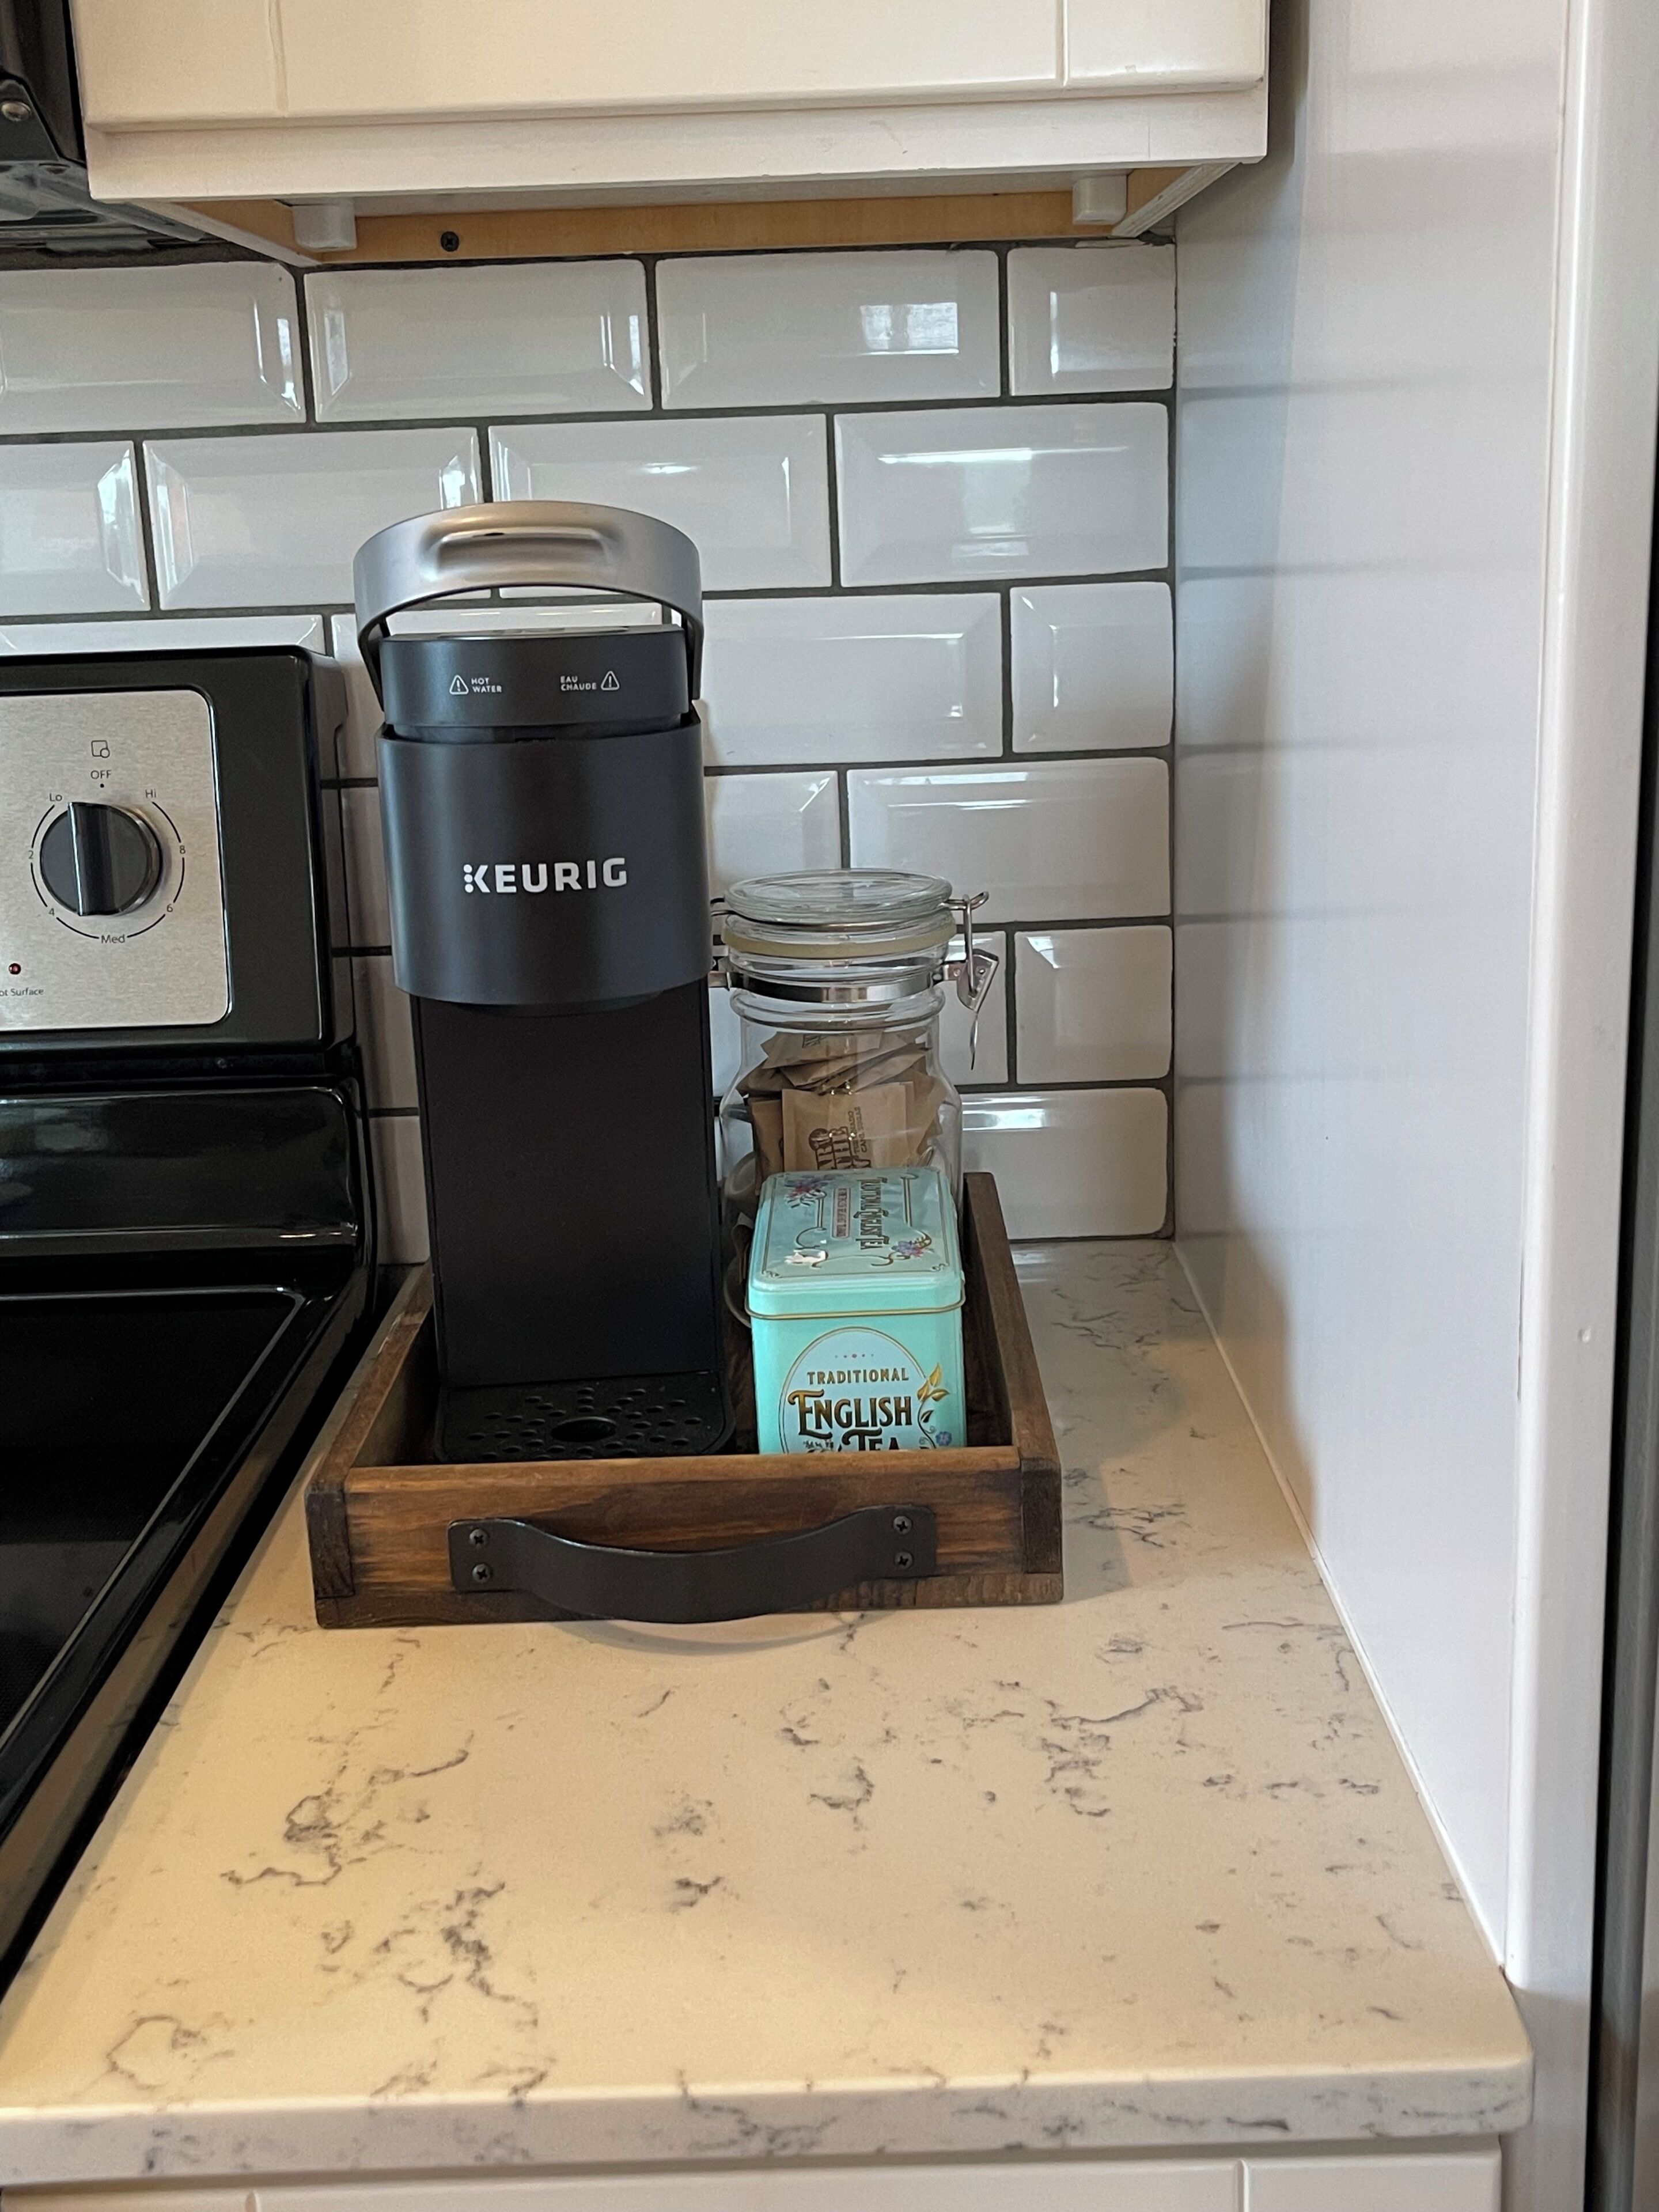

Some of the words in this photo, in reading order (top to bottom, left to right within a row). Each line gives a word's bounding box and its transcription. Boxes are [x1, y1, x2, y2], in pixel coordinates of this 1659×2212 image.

[471, 677, 490, 685] HOT
[560, 683, 597, 691] CHAUDE
[90, 770, 112, 780] OFF
[50, 793, 63, 802] Lo
[145, 789, 157, 798] Hi
[179, 845, 186, 854] 8
[28, 850, 34, 859] 2
[463, 857, 628, 893] KEURIG
[48, 908, 55, 916] 4
[166, 904, 173, 912] 6
[101, 934, 126, 944] Med
[10, 987, 44, 997] Surface
[806, 1367, 910, 1385] TRADITIONAL
[787, 1388, 912, 1439] ENGLISH
